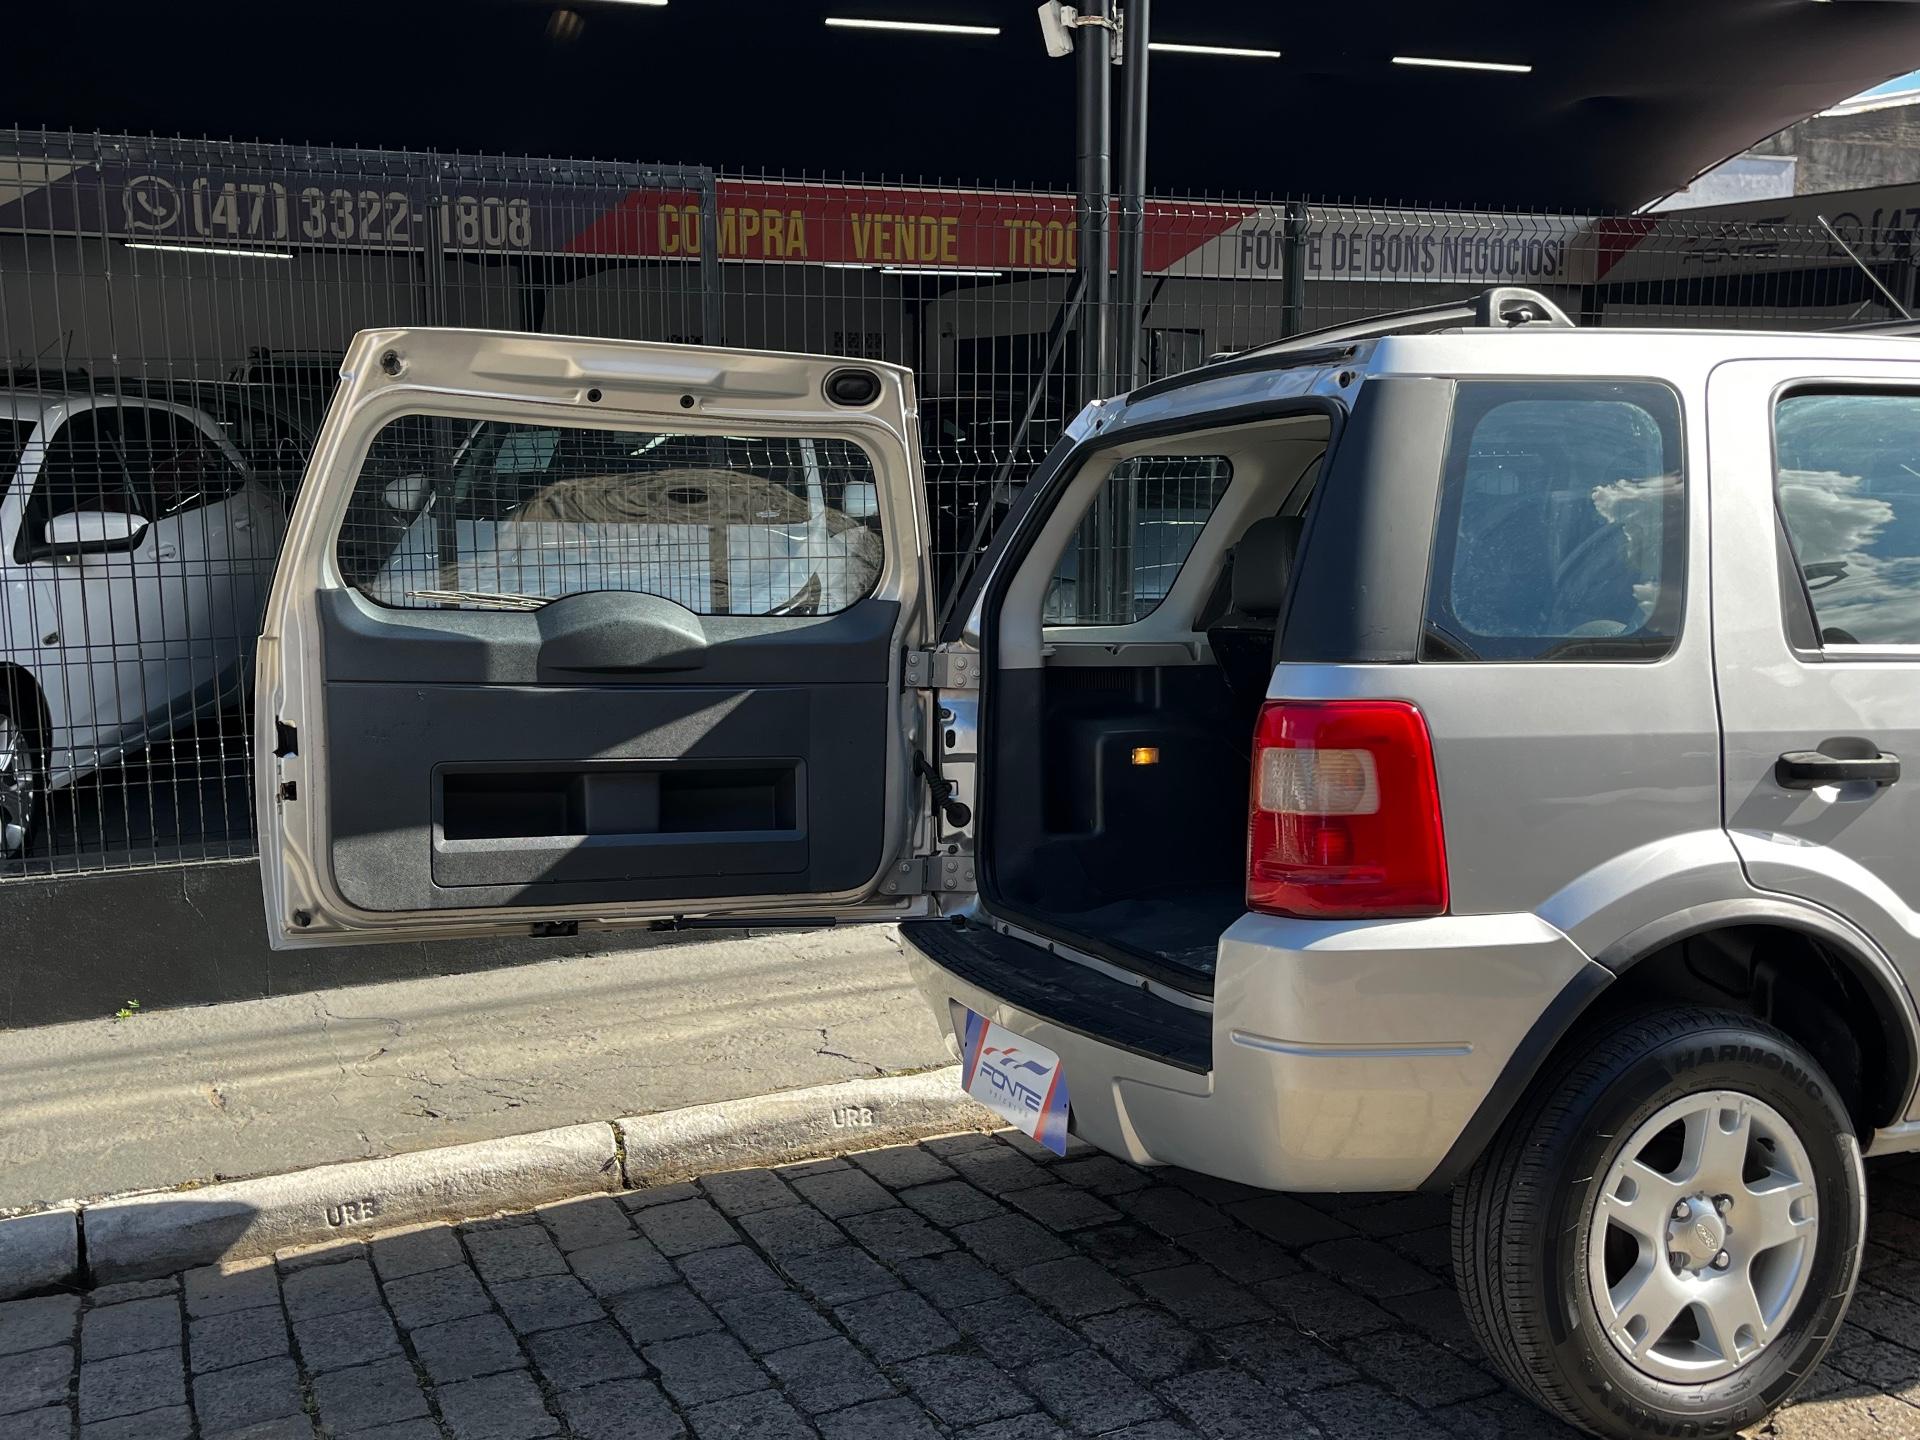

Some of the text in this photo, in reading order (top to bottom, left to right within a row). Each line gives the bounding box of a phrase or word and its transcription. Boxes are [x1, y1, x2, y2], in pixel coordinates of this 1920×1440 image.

[192, 177, 532, 247] (47) 3322-1808
[658, 204, 1077, 267] COMPRA VENDE TROC
[1240, 229, 1565, 276] FONE DE BONS NEGÓCIOS!
[980, 1060, 1042, 1113] FONTE
[832, 1104, 875, 1129] URB
